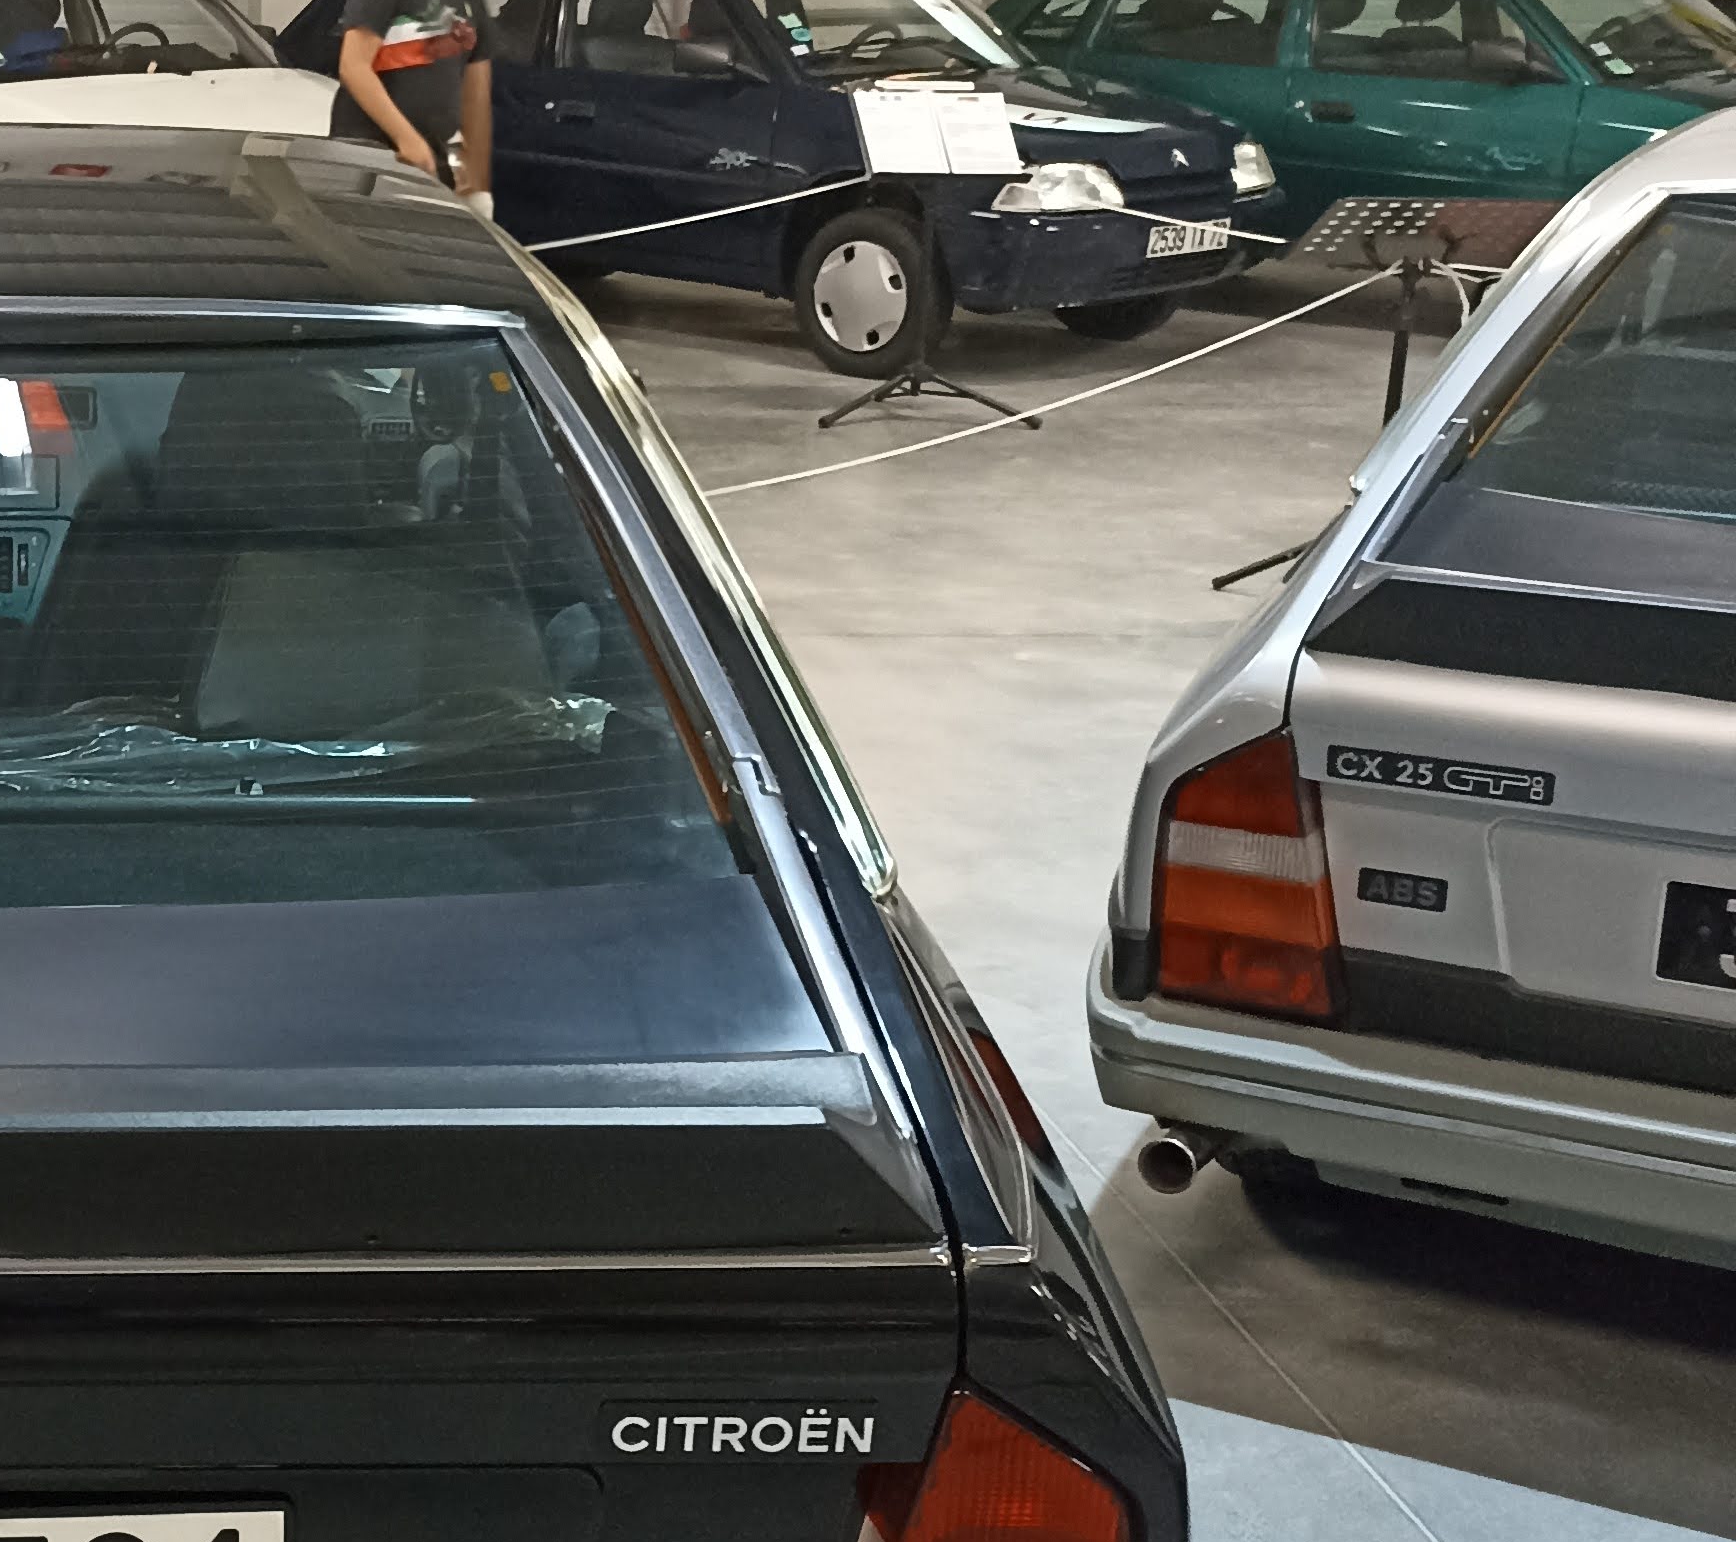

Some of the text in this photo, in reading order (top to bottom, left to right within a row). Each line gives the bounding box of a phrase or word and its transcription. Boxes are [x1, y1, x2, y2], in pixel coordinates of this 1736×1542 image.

[1336, 752, 1383, 779] CX
[1395, 759, 1433, 786] 25
[1365, 873, 1439, 907] ABS
[611, 1408, 874, 1454] CITROËN
